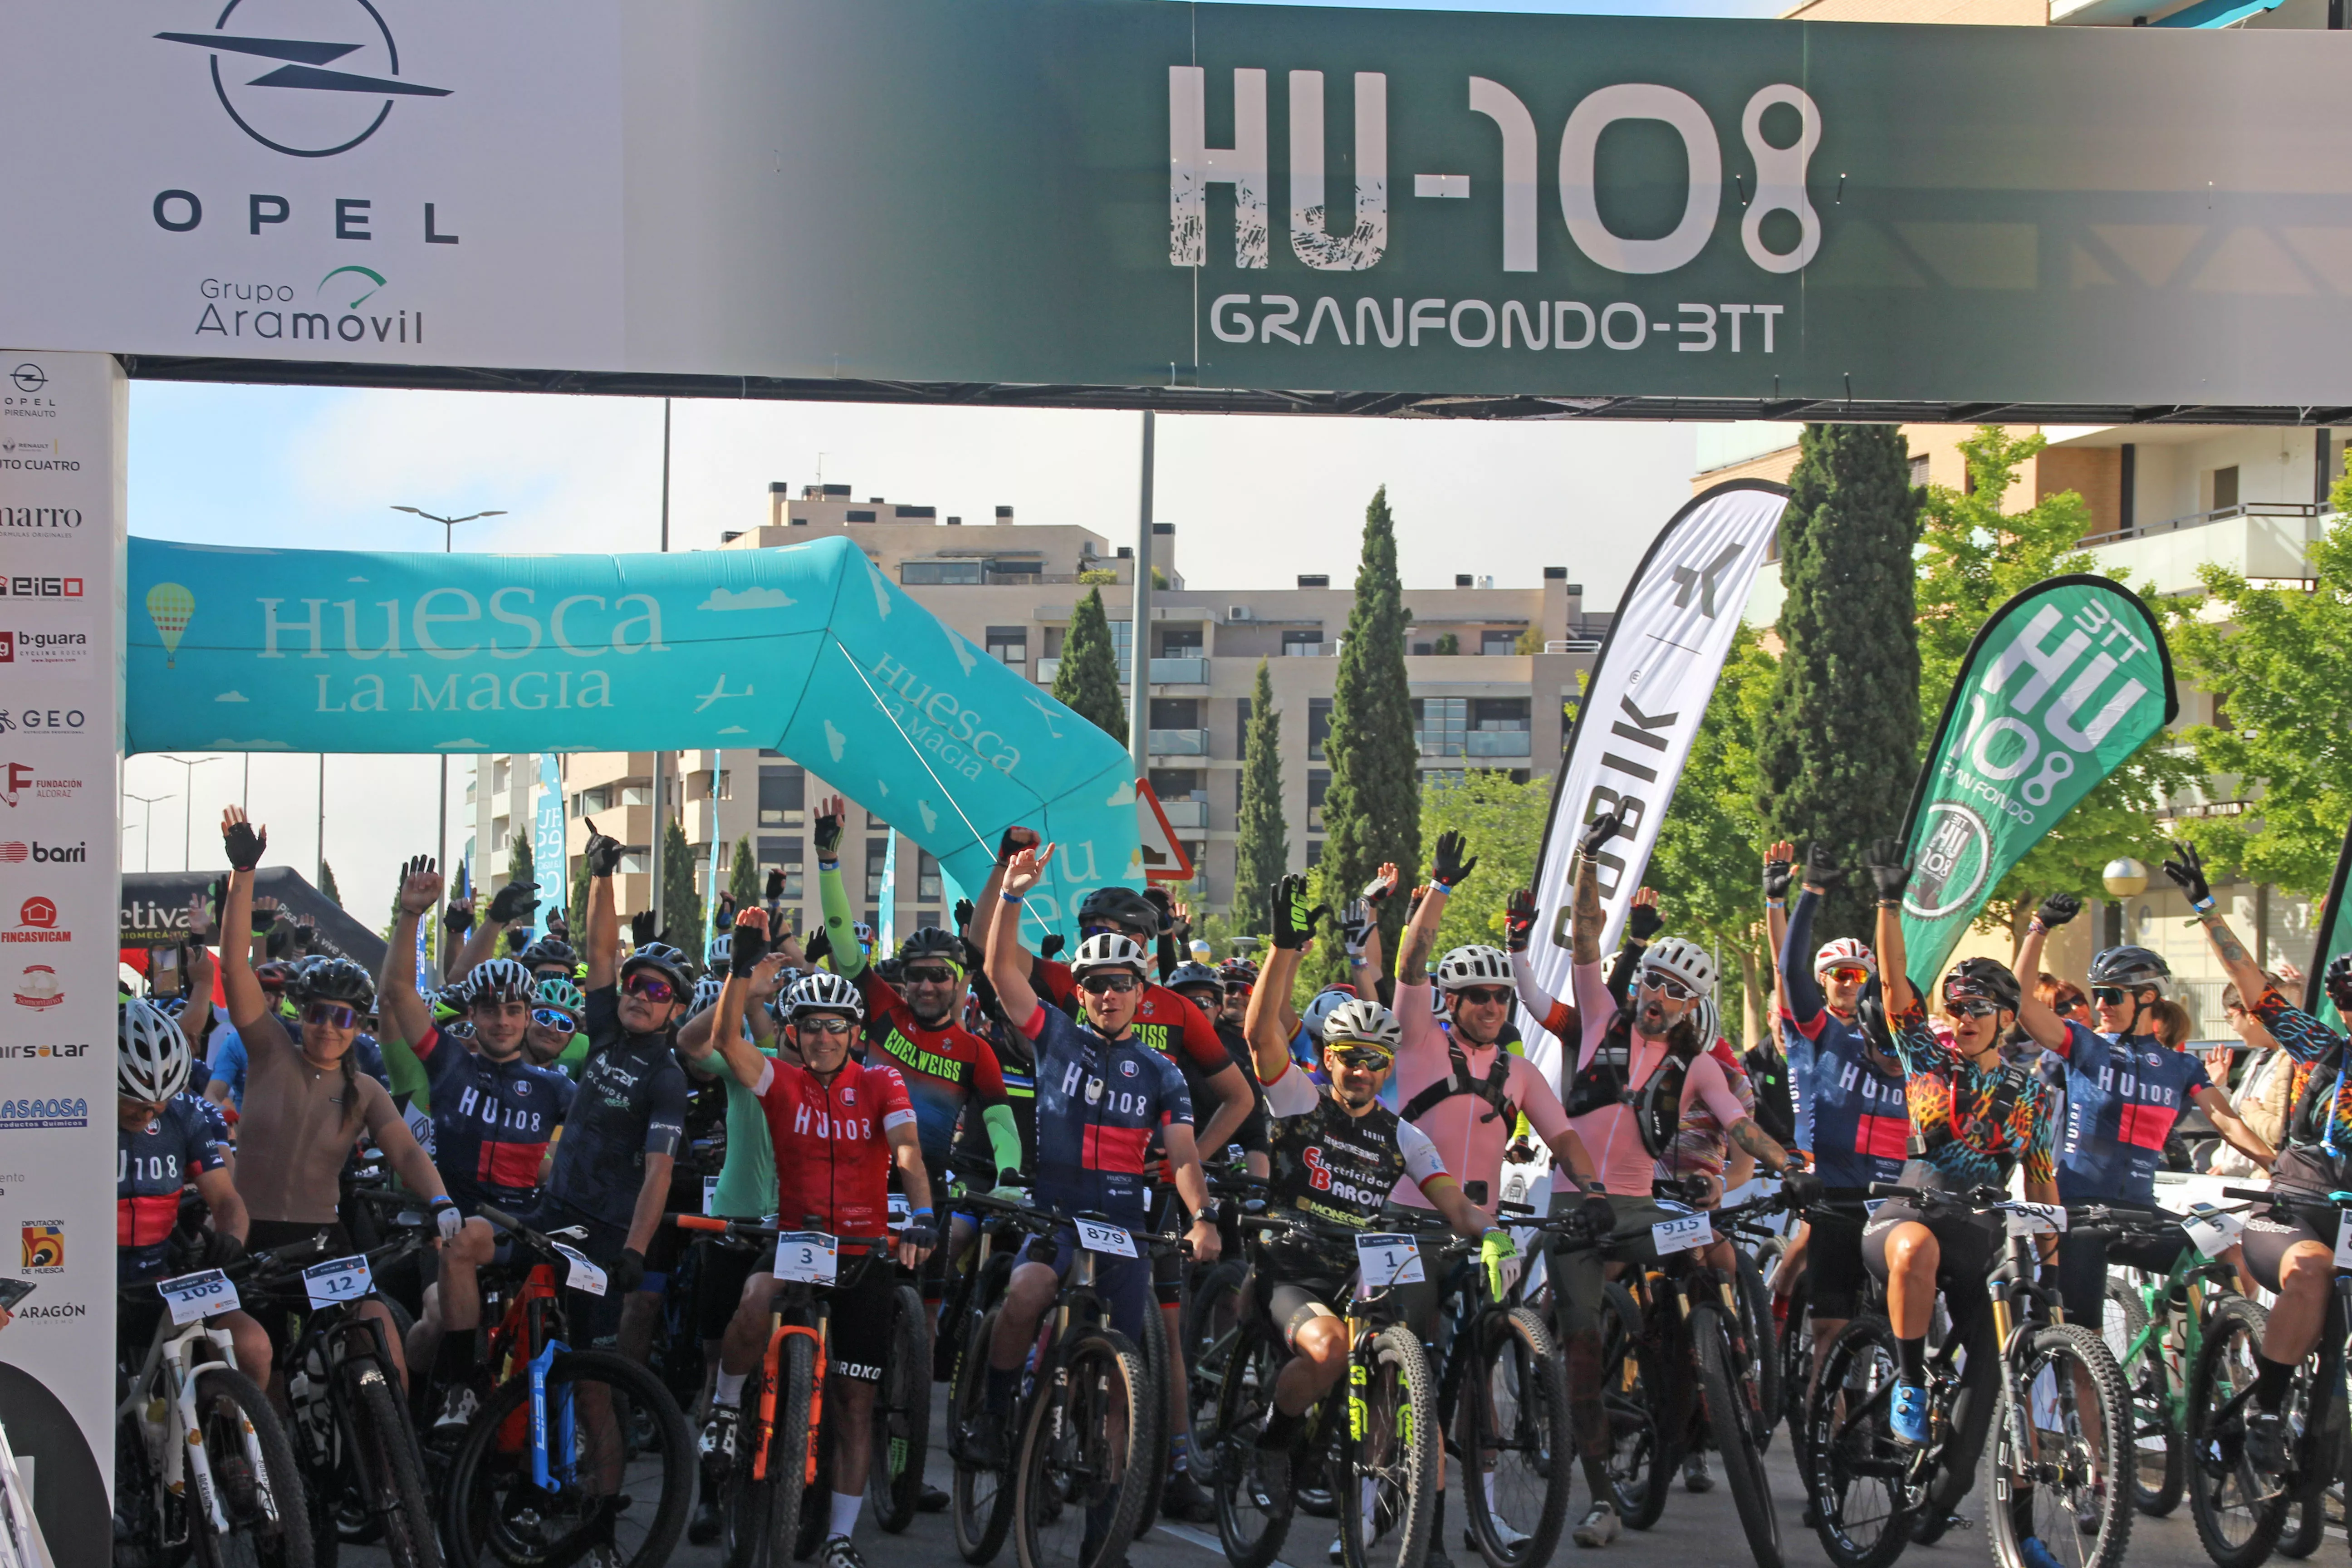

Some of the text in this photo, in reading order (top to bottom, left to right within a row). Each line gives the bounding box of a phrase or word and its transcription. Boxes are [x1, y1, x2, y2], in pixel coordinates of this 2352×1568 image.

[1169, 65, 1822, 274] HU-108
[153, 189, 459, 245] OPEL
[201, 278, 294, 304] Grupo
[195, 303, 422, 345] Aramovil
[5, 397, 55, 407] OPEL
[5, 409, 56, 417] PIRENAUTO
[25, 460, 80, 471] CUATRO
[1980, 603, 2148, 753] HU
[23, 710, 84, 728] GEO
[1948, 693, 2074, 806] 108
[36, 779, 82, 788] FUNDACIÓN
[33, 841, 86, 862] barri
[1921, 847, 1952, 877] 108
[1, 931, 71, 942] FINCASVICAM
[883, 1027, 962, 1082] EDELWEISS
[1838, 1061, 1904, 1106] HU10
[1308, 1166, 1385, 1208] BARON
[1087, 1227, 1125, 1244] 879
[1662, 1218, 1700, 1235] 915
[801, 1248, 813, 1264] 3
[1384, 1251, 1397, 1268] 1
[325, 1276, 355, 1294] 12
[20, 1303, 85, 1318] ARAGÓN
